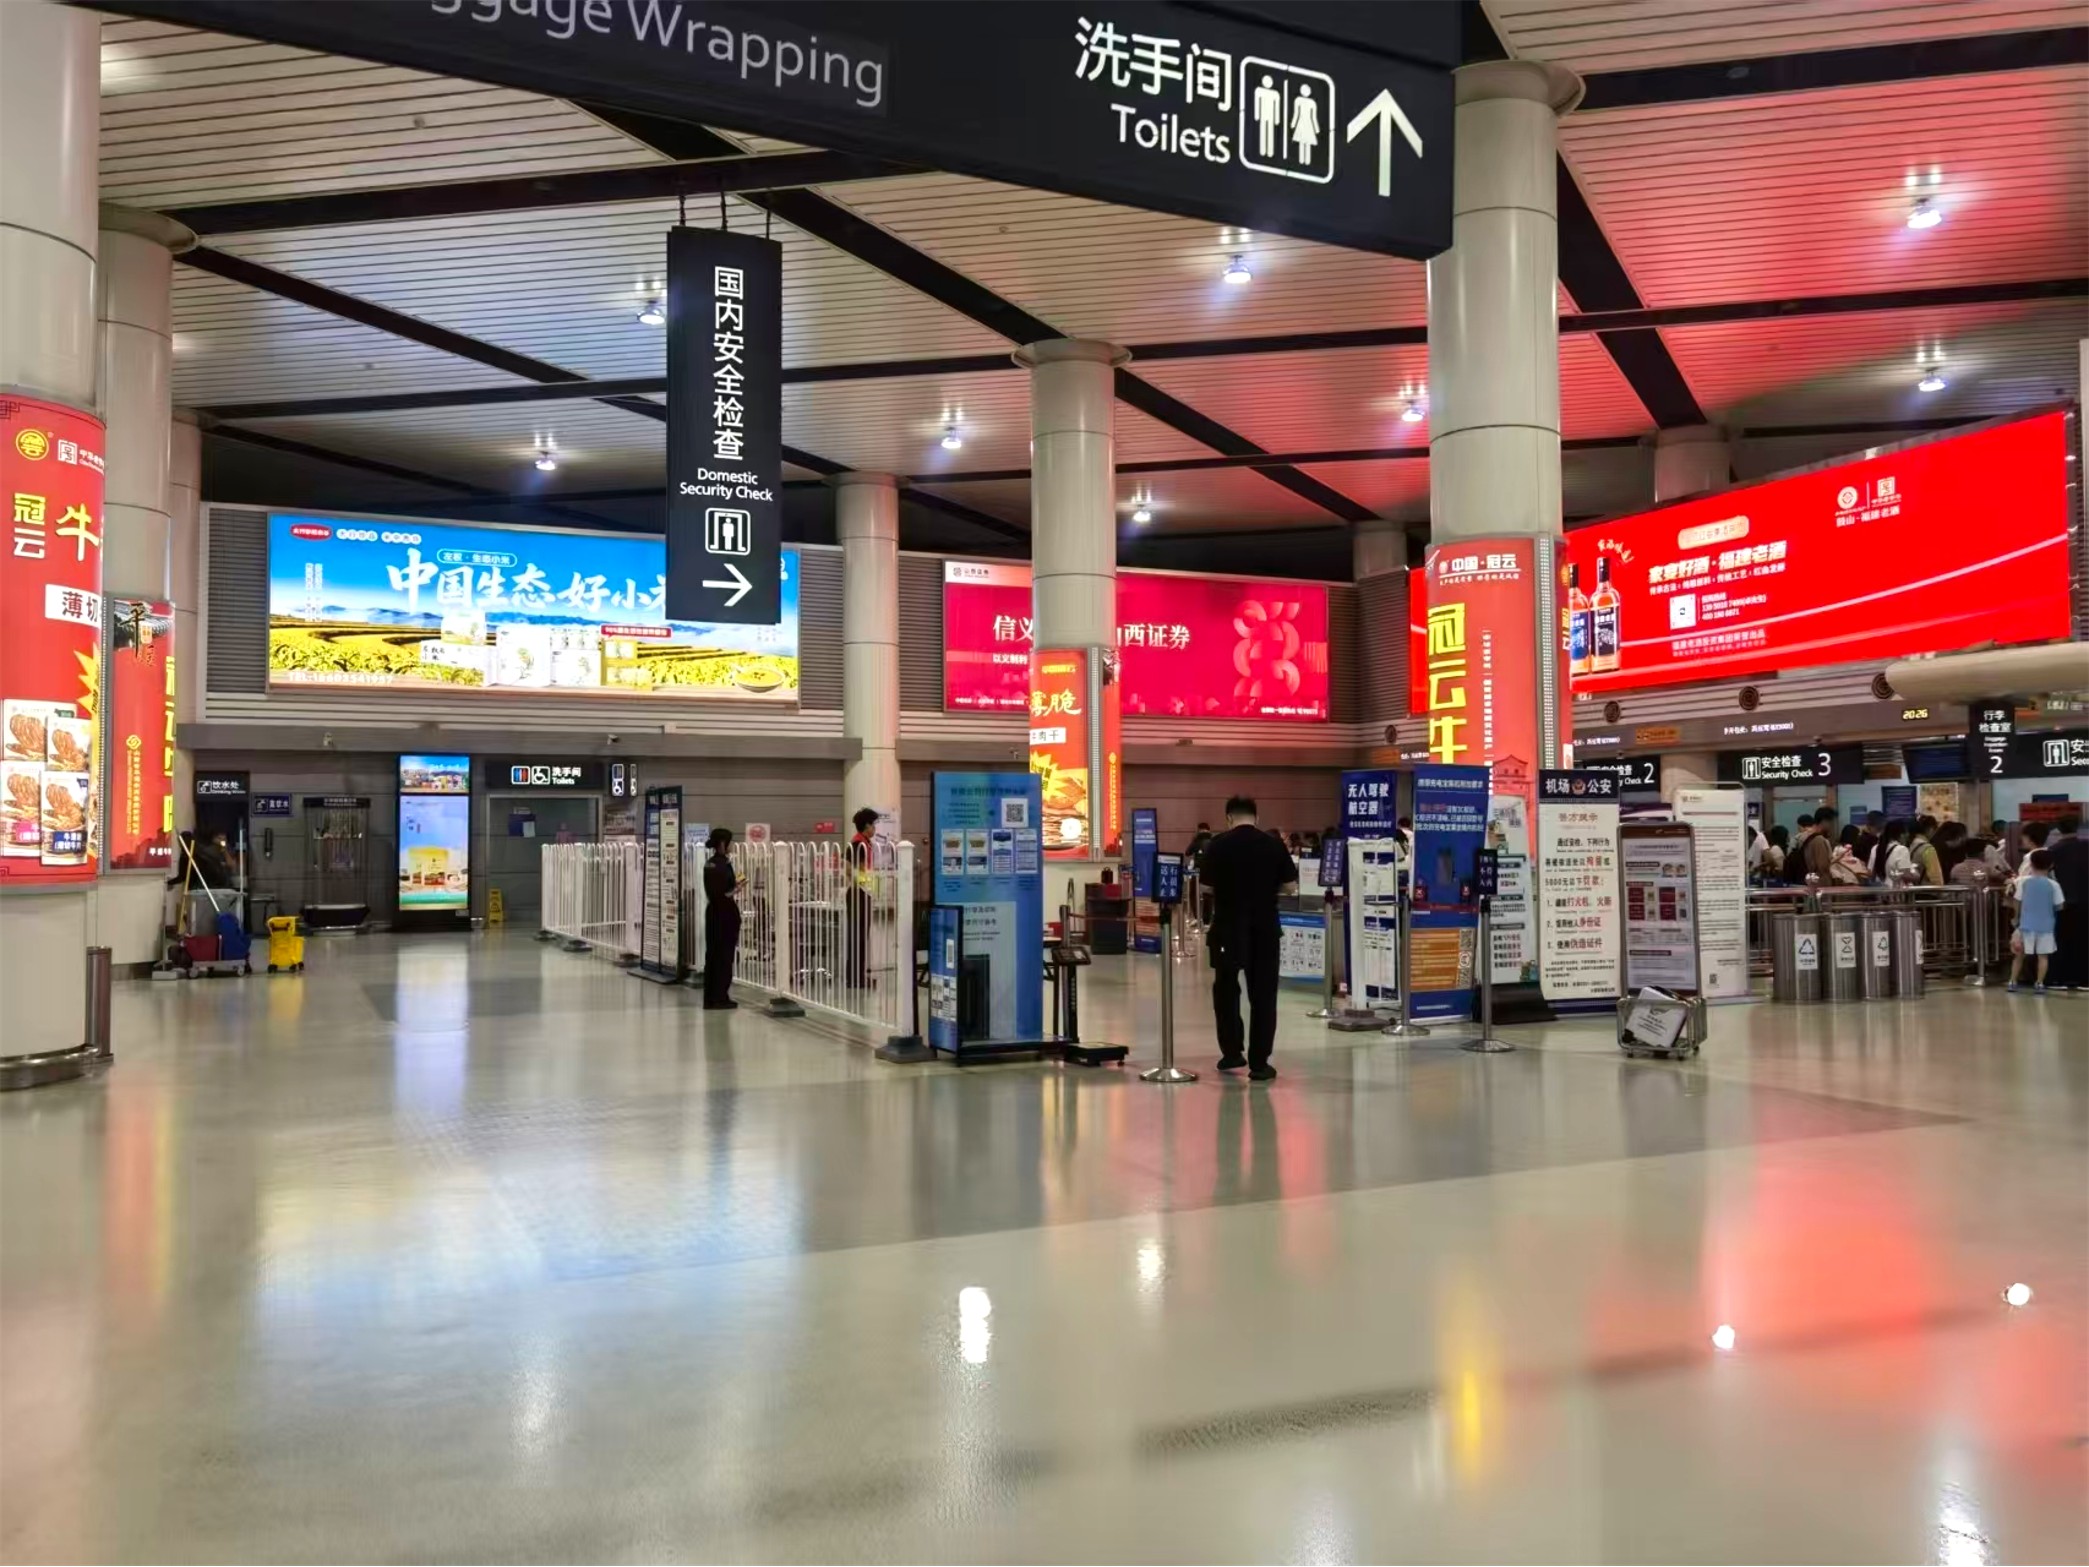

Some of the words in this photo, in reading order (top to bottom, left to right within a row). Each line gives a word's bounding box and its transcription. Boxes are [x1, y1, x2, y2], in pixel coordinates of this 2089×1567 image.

[627, 0, 883, 107] Wrapping
[1074, 16, 1233, 112] 洗手间
[1111, 102, 1231, 164] Toilets
[712, 265, 745, 461] 国内安全检查
[697, 467, 759, 485] Domestic
[679, 481, 733, 500] Security
[735, 483, 774, 502] Check
[13, 492, 46, 560] 冠云
[55, 503, 101, 562] 牛
[1117, 621, 1192, 650] 西证券
[552, 767, 582, 777] 洗手间
[1644, 762, 1655, 783] 2
[1761, 755, 1802, 768] 安全检查
[1818, 753, 1831, 776] 3
[1990, 755, 2004, 773] 2
[553, 777, 576, 785] Toilets
[1624, 776, 1641, 785] Check
[1761, 769, 1790, 780] Security
[1791, 768, 1813, 778] Check
[212, 781, 239, 789] 饮水处
[1348, 783, 1389, 798] 无人驾驶
[1545, 778, 1570, 794] 机场
[1587, 778, 1611, 794] 公安
[1348, 801, 1378, 815] 航空器
